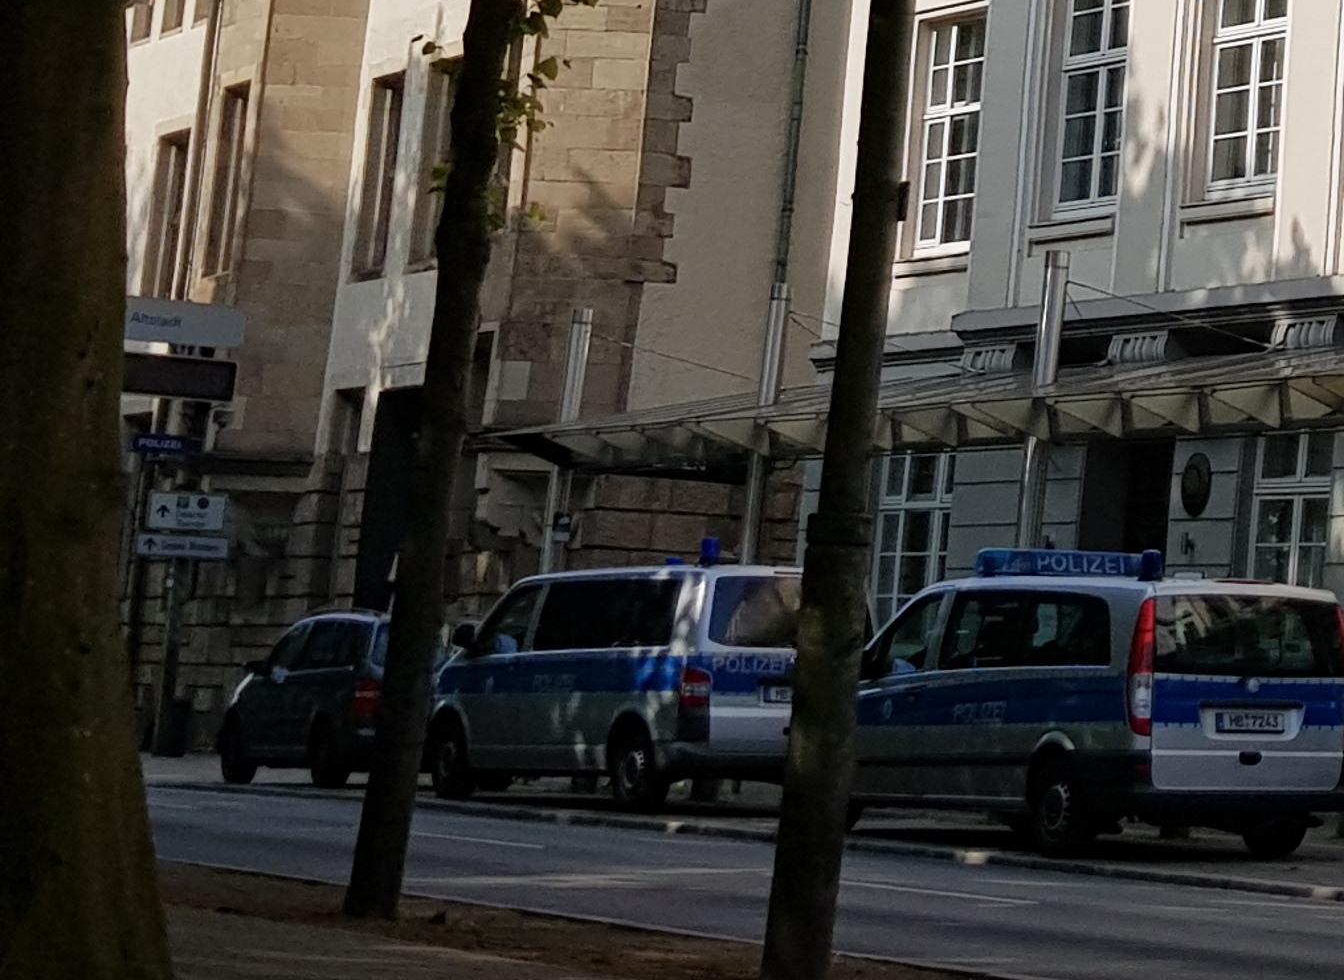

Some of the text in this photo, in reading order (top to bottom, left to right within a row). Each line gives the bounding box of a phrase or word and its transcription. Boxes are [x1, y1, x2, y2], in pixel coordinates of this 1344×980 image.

[138, 437, 182, 450] POLIZEI
[1037, 555, 1126, 574] POLIZEI
[712, 655, 787, 674] POLIZEI
[953, 700, 1007, 723] POLIZEI
